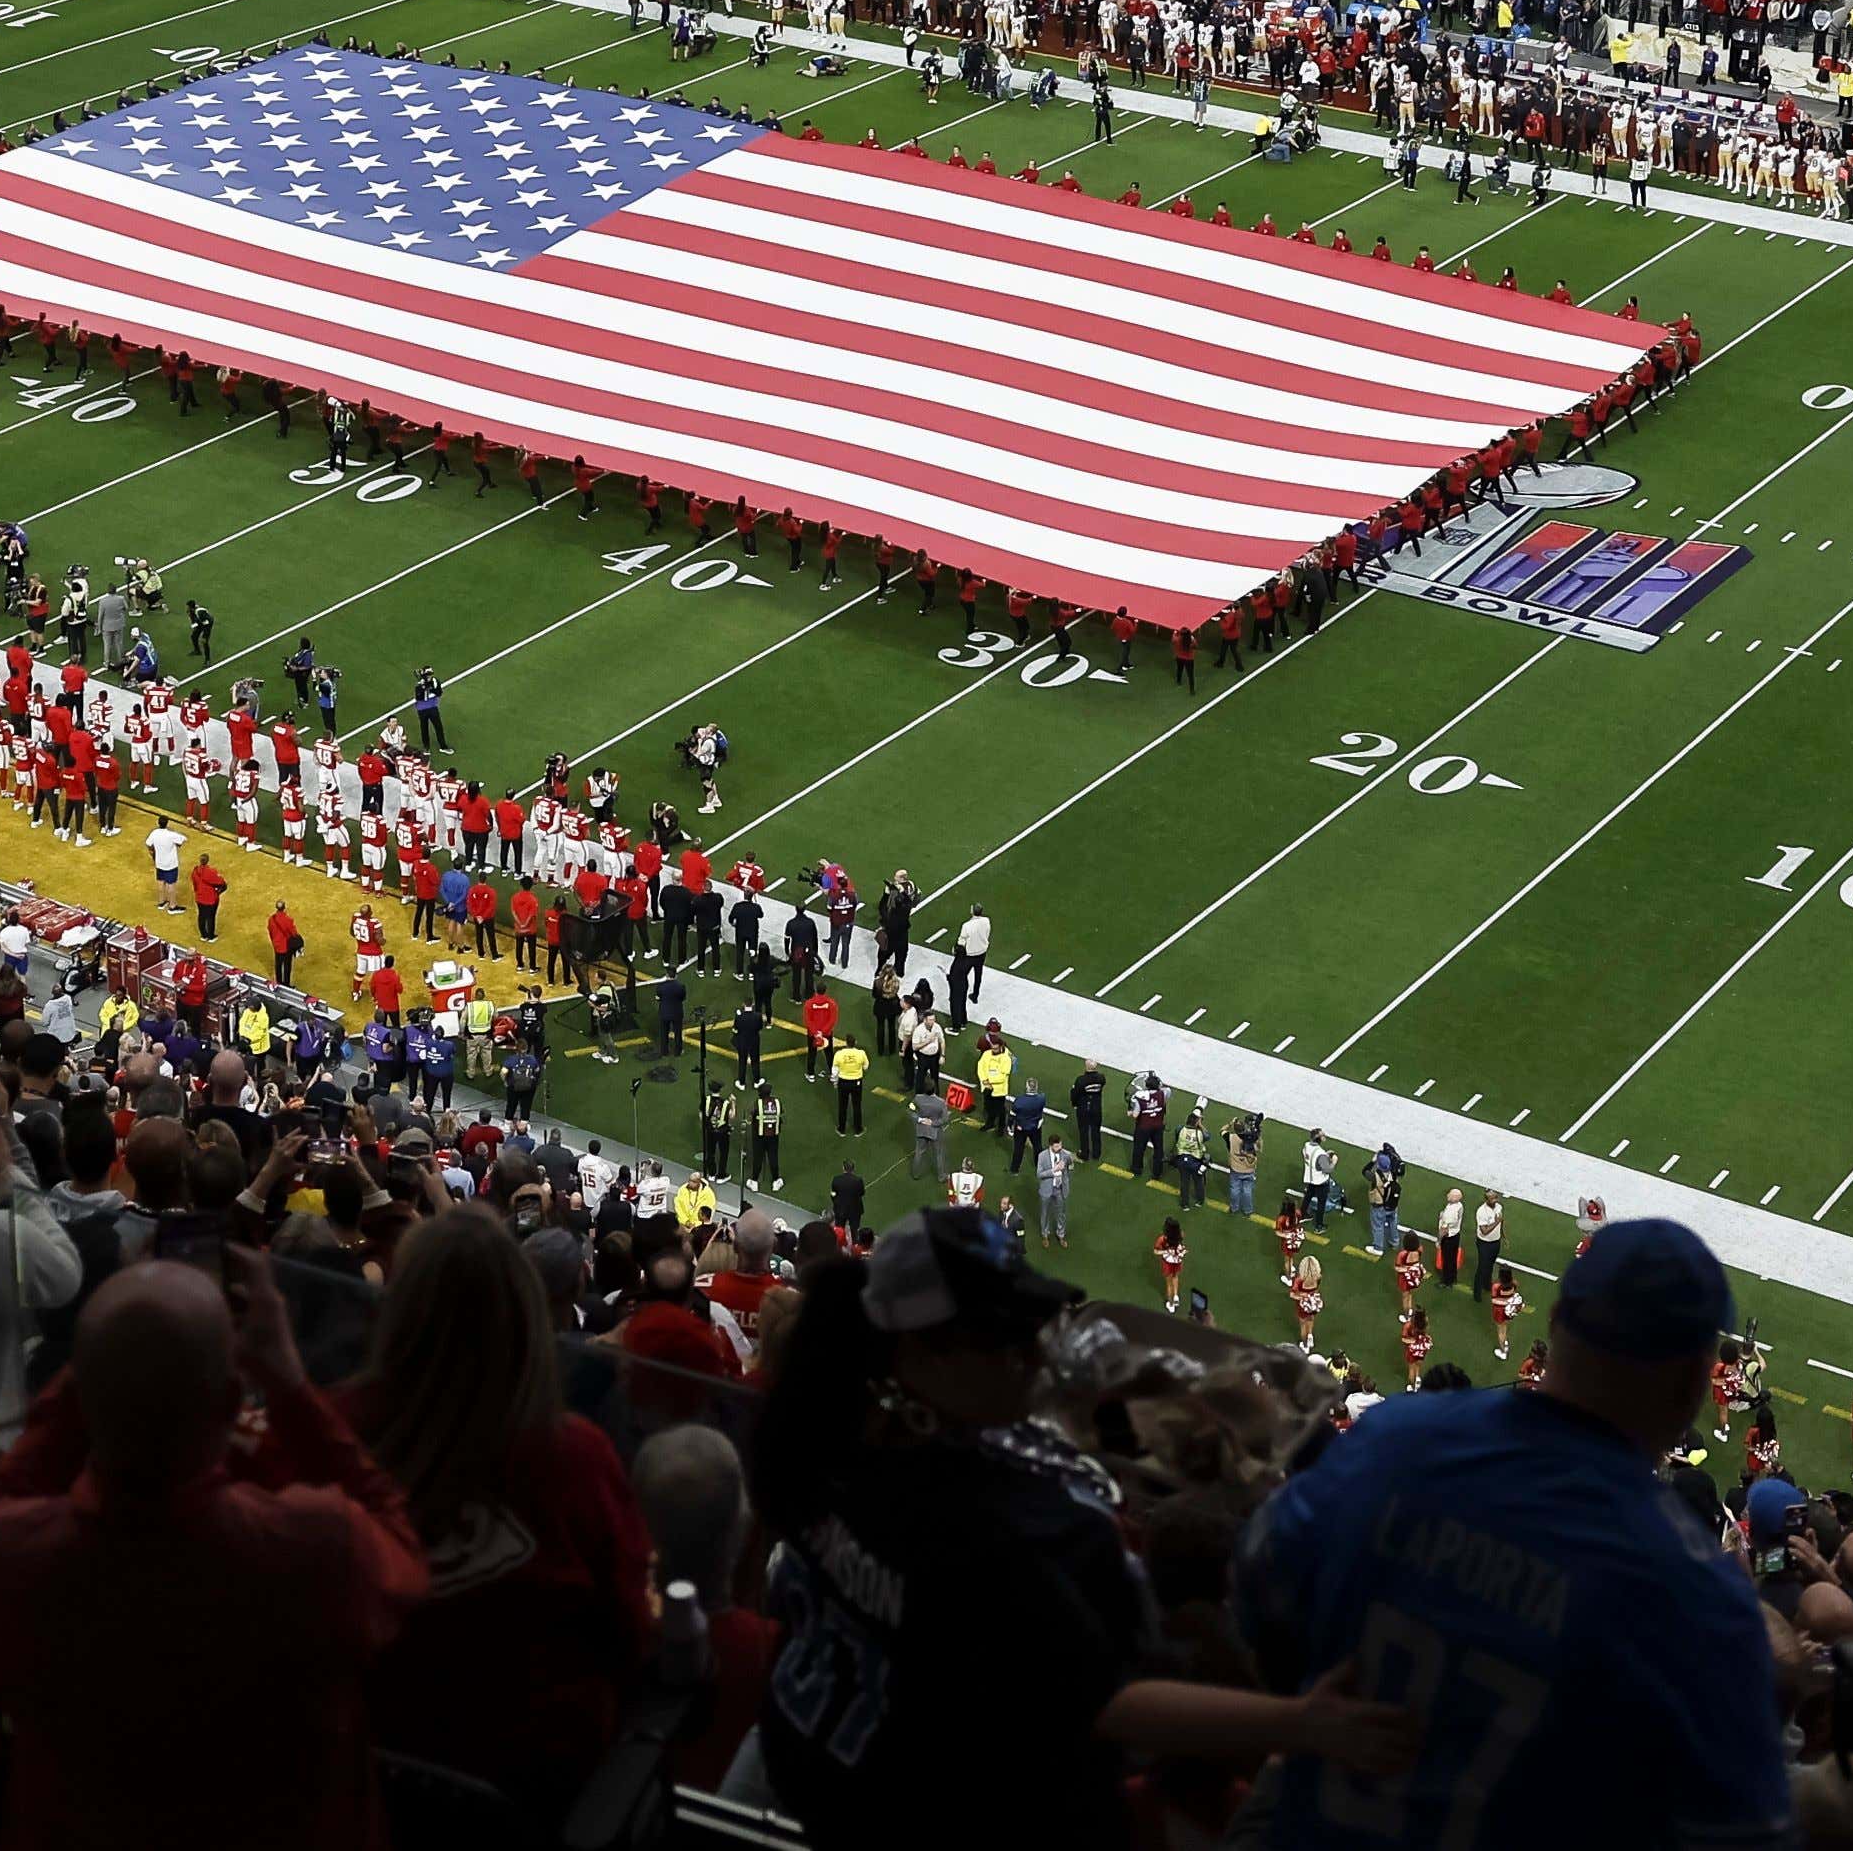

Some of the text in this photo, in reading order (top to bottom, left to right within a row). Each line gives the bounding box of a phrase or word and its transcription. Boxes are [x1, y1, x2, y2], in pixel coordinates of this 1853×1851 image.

[16, 381, 138, 424] 40
[288, 459, 424, 503] 50
[601, 544, 740, 591] 40
[1420, 586, 1602, 638] BOWL
[937, 631, 1091, 688] 30
[149, 696, 166, 708] 41
[186, 709, 196, 722] 5
[184, 759, 200, 776] 23
[1311, 732, 1478, 794] 20
[235, 774, 251, 792] 32
[441, 787, 457, 801] 97
[360, 820, 377, 838] 98
[398, 831, 412, 848] 92
[740, 871, 752, 887] 7
[946, 1086, 965, 1107] 20
[582, 1173, 596, 1188] 15
[649, 1194, 664, 1206] 15
